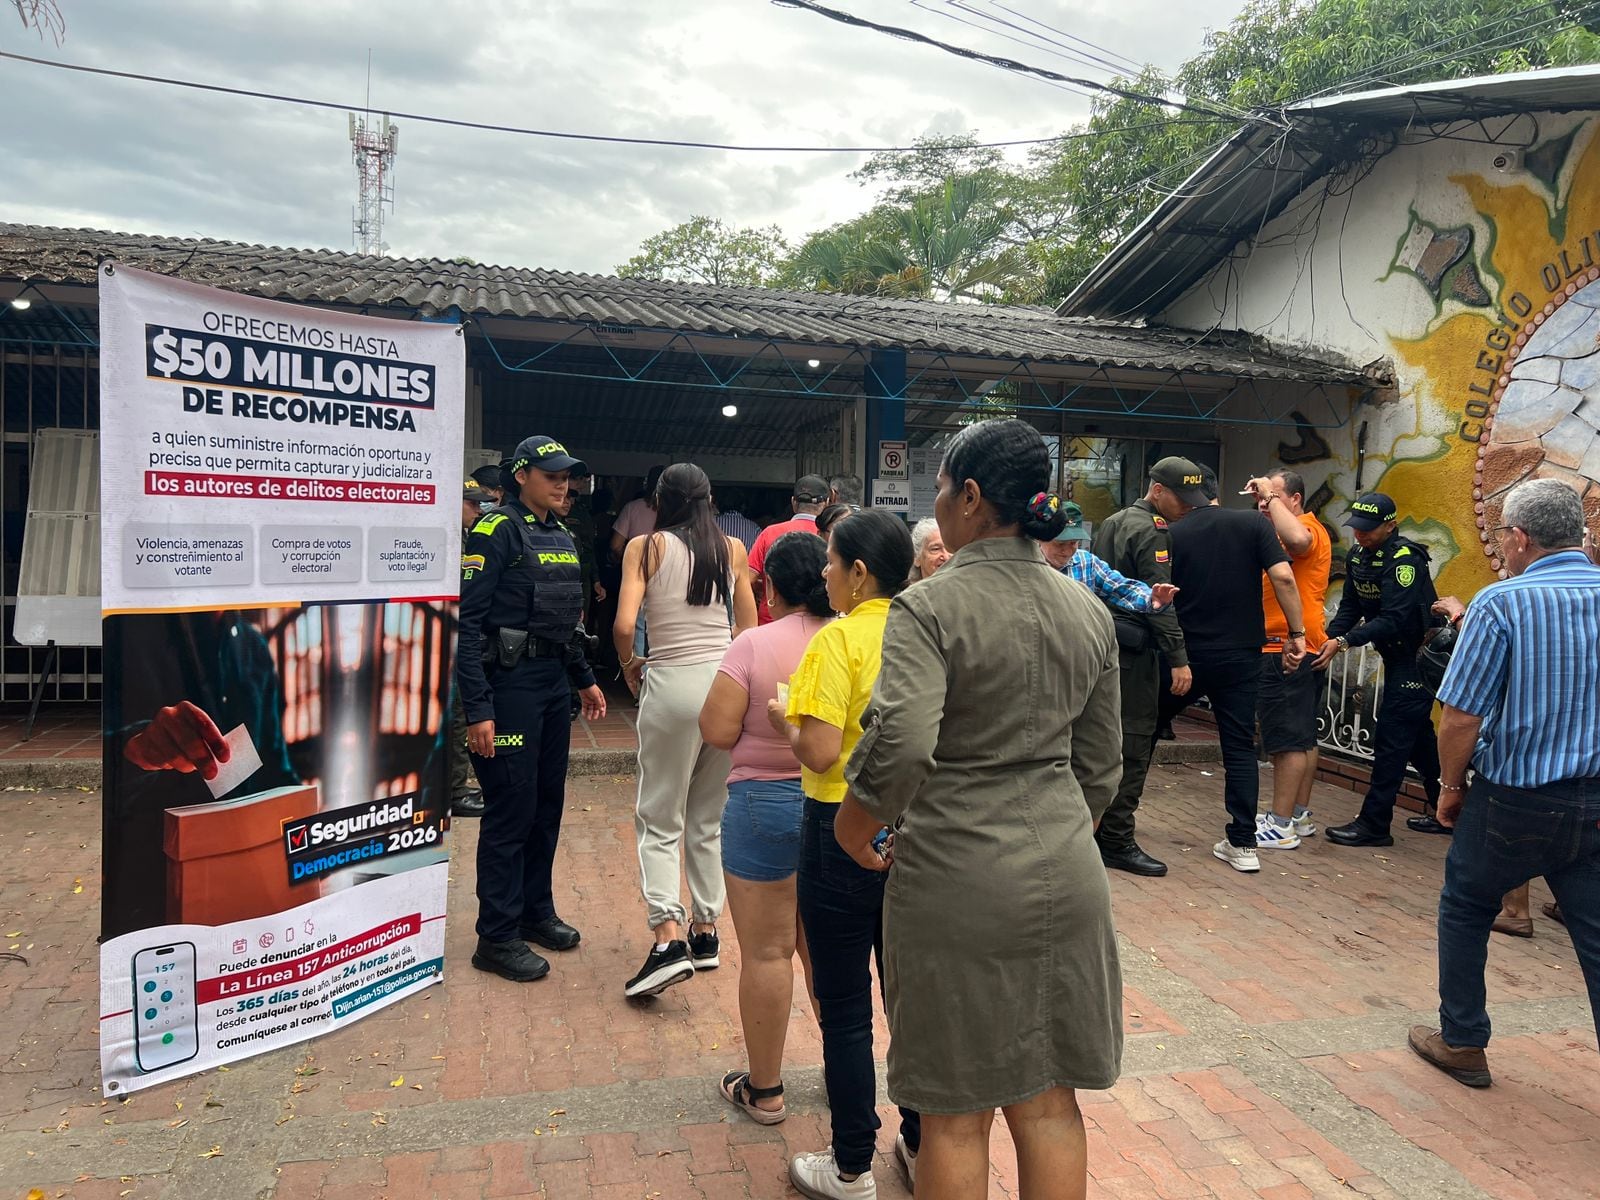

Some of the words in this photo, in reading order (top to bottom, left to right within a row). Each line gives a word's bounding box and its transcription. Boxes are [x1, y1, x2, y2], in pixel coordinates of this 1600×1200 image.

[203, 311, 334, 348] OFRECEMOS
[340, 333, 399, 358] HASTA
[153, 328, 231, 378] $50
[244, 346, 430, 402] MILLONES
[183, 386, 223, 415] DE
[232, 392, 416, 432] RECOMPENSA
[152, 432, 160, 443] a
[165, 431, 206, 447] quien
[210, 435, 284, 452] suministre
[287, 439, 365, 457] información
[368, 447, 422, 461] oportuna
[424, 452, 431, 464] y
[150, 451, 201, 467] precisa
[205, 455, 232, 471] que
[236, 457, 290, 472] permita
[294, 461, 349, 475] capturar
[352, 465, 360, 478] y
[361, 462, 423, 479] judicializar
[426, 470, 432, 479] a
[151, 473, 179, 492] los
[184, 478, 253, 494] autores
[258, 479, 281, 496] de
[286, 480, 344, 498] delitos
[348, 484, 431, 502] electorales
[875, 496, 908, 505] ENTRADA
[136, 537, 190, 549] Violencia,
[192, 541, 244, 549] amenazas
[272, 539, 310, 550] Compra
[313, 539, 325, 549] de
[327, 540, 351, 549] votos
[282, 553, 288, 563] y
[290, 550, 341, 562] corrupción
[380, 551, 428, 562] suplantación
[429, 552, 435, 561] y
[394, 539, 423, 550] Fraude,
[136, 554, 144, 565] y
[146, 551, 233, 563] constreñimiento
[235, 551, 244, 561] al
[175, 566, 212, 575] votante
[291, 562, 332, 573] electoral
[388, 563, 406, 571] voto
[407, 562, 427, 573] ilegal
[310, 798, 413, 845] Seguridad
[293, 839, 384, 880] Democracia
[387, 825, 437, 852] 2026
[219, 958, 257, 974] Puede
[260, 941, 315, 964] denunciar
[316, 939, 328, 948] en
[329, 933, 337, 944] la
[220, 981, 240, 994] La
[246, 969, 293, 989] Línea
[298, 957, 319, 977] 157
[321, 922, 411, 966] Anticorrupción
[155, 963, 175, 973] 157
[216, 1007, 234, 1018] Los
[236, 996, 265, 1012] 365
[268, 989, 299, 1004] días
[302, 985, 316, 997] del
[331, 974, 341, 984] las
[343, 964, 357, 979] 24
[359, 953, 389, 972] horas
[390, 950, 400, 960] del
[216, 1017, 247, 1032] desde
[249, 1004, 298, 1022] cualquier
[300, 998, 319, 1012] tipo
[321, 992, 329, 1003] de
[329, 979, 359, 998] teléfono
[360, 977, 365, 986] y
[366, 973, 375, 982] en
[376, 966, 393, 978] todo
[395, 961, 401, 970] el
[402, 955, 416, 969] país
[217, 1024, 287, 1049] Comuníquese
[290, 1018, 299, 1028] al
[301, 1009, 332, 1025] correo:
